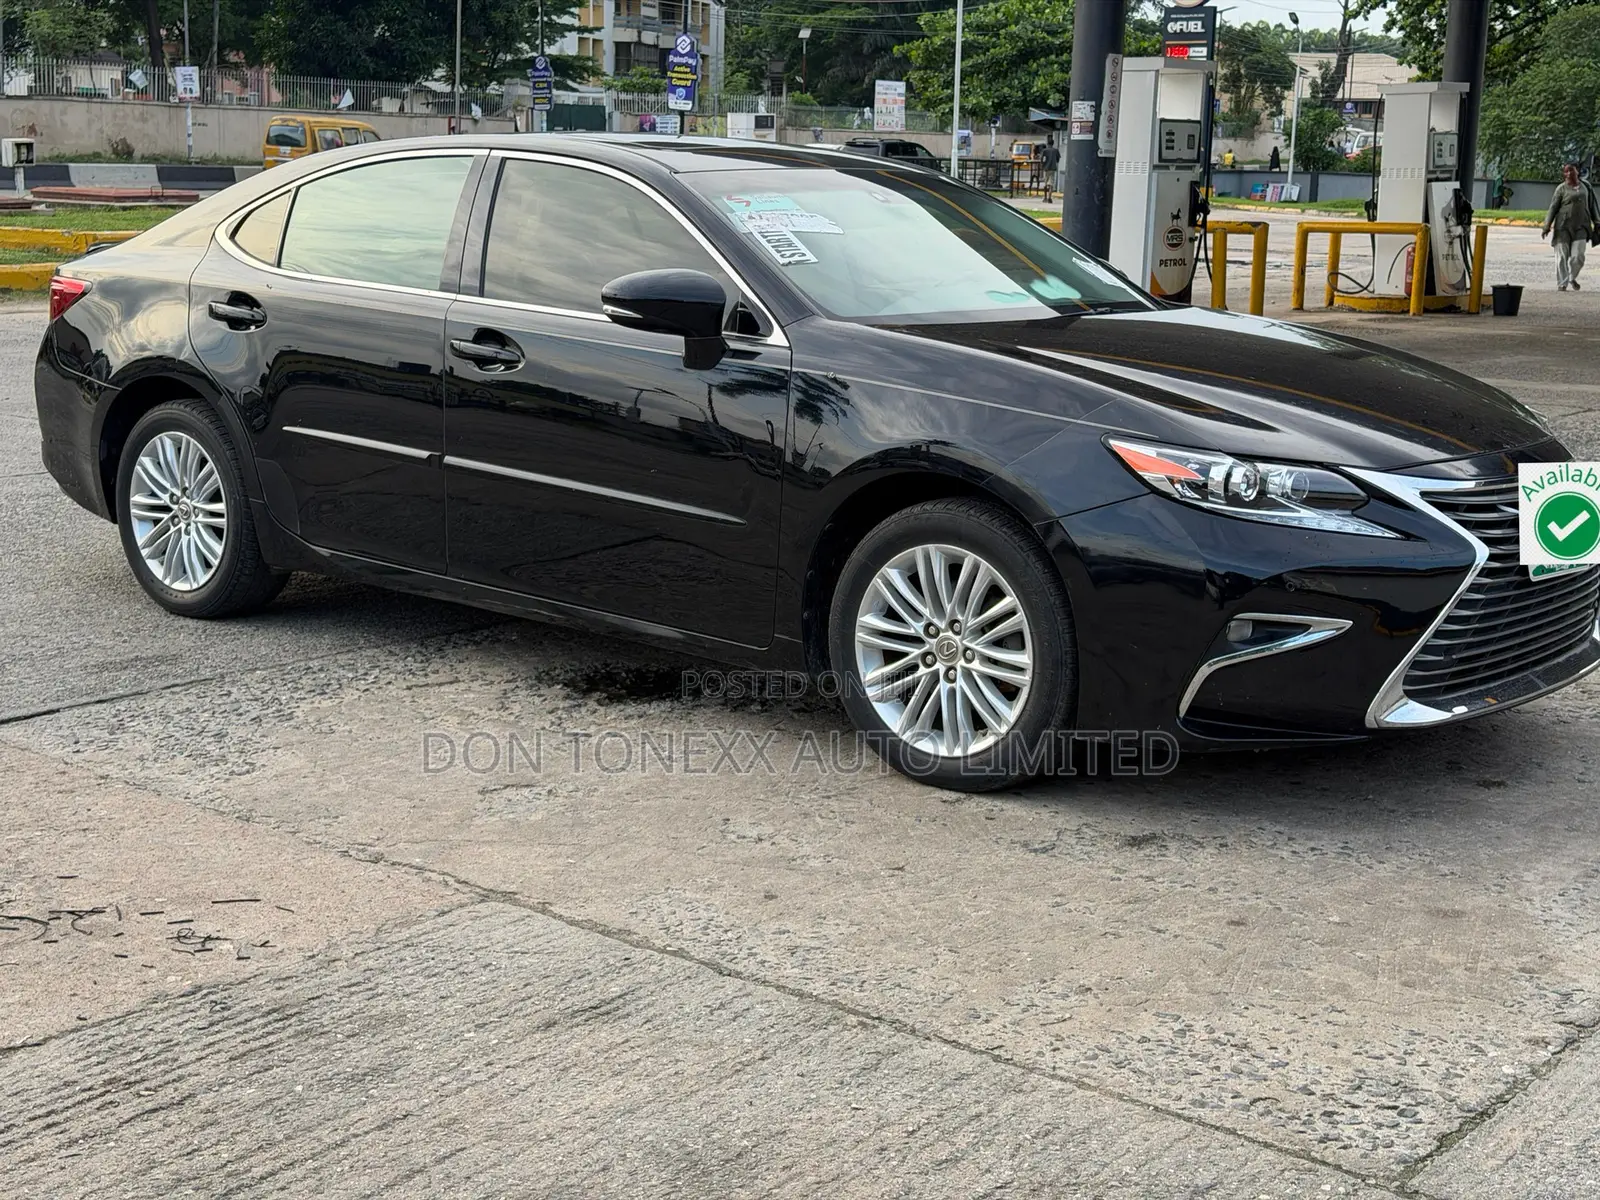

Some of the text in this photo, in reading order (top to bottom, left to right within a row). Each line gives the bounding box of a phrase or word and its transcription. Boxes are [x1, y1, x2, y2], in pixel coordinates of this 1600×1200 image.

[668, 54, 697, 66] PalmPay
[1166, 233, 1184, 242] MRS
[1159, 258, 1187, 267] PETROL
